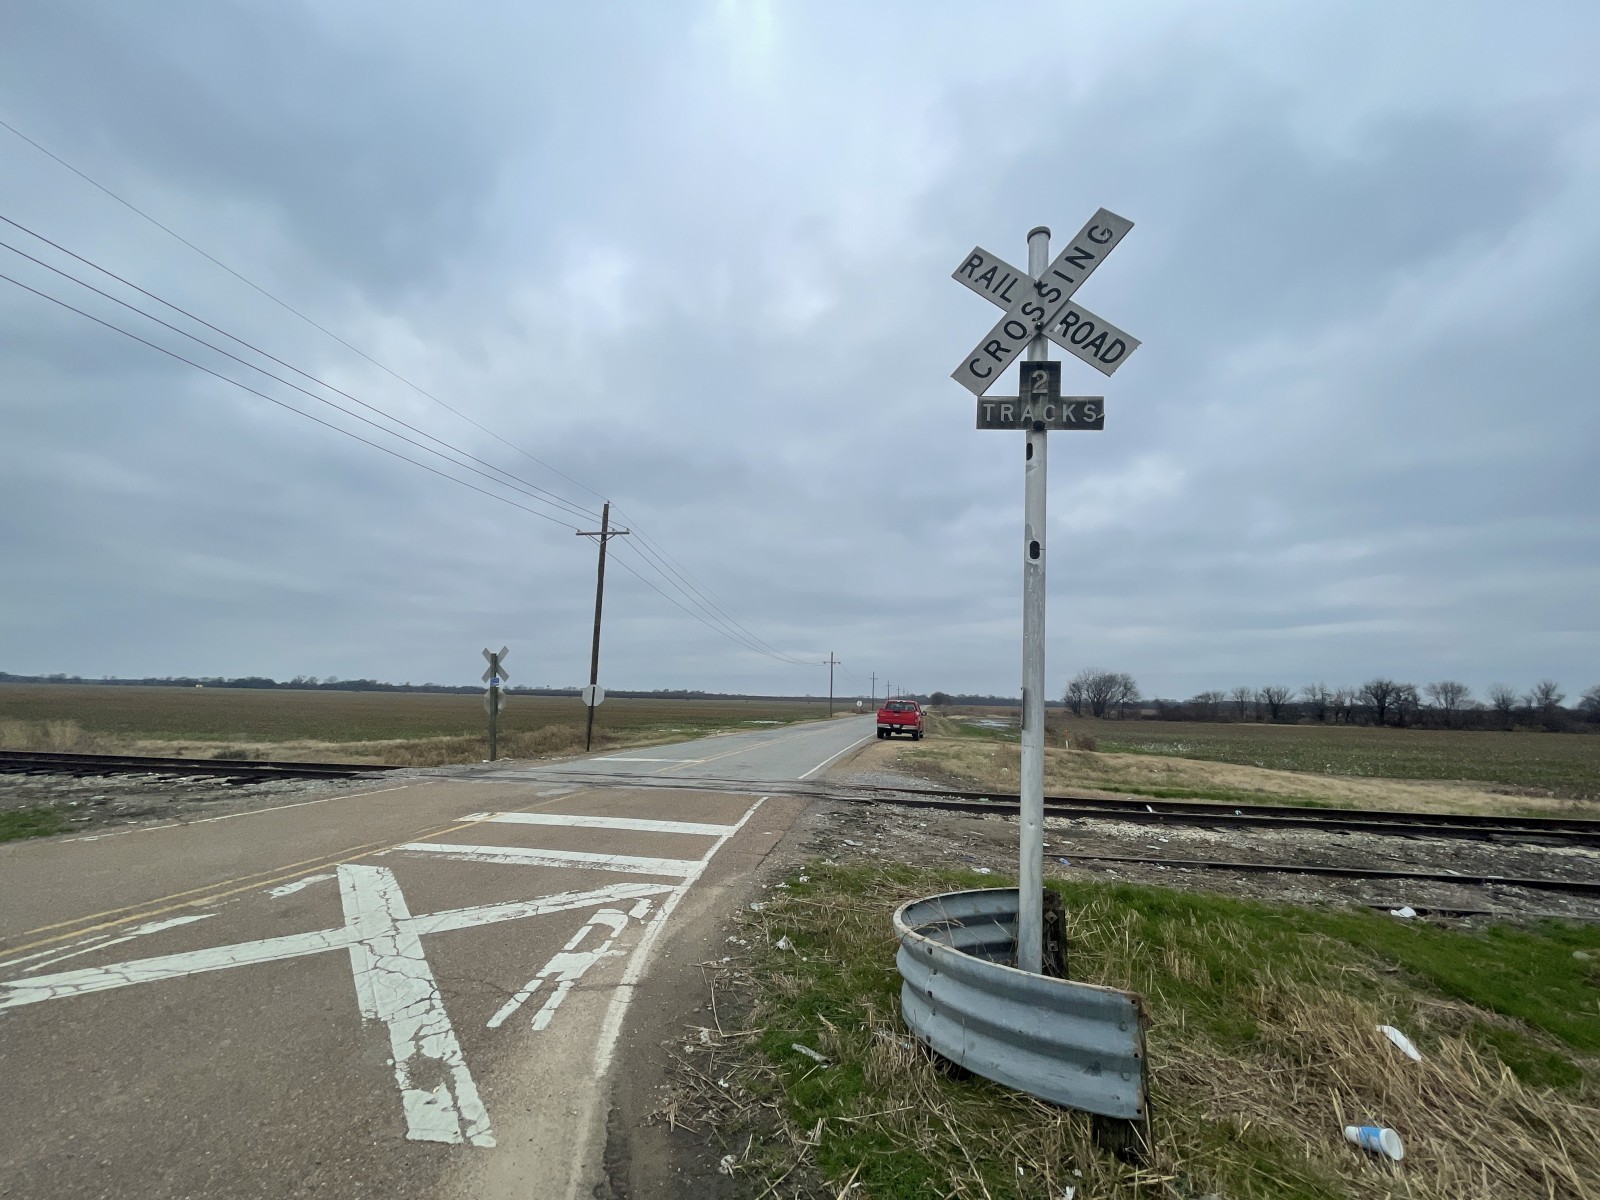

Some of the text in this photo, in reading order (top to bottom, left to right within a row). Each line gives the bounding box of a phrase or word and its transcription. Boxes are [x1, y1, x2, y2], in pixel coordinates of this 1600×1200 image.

[959, 253, 1127, 364] RAIL ROAD
[968, 224, 1114, 379] CROSSING
[982, 403, 1098, 423] TRACKS
[1031, 369, 1048, 394] 2
